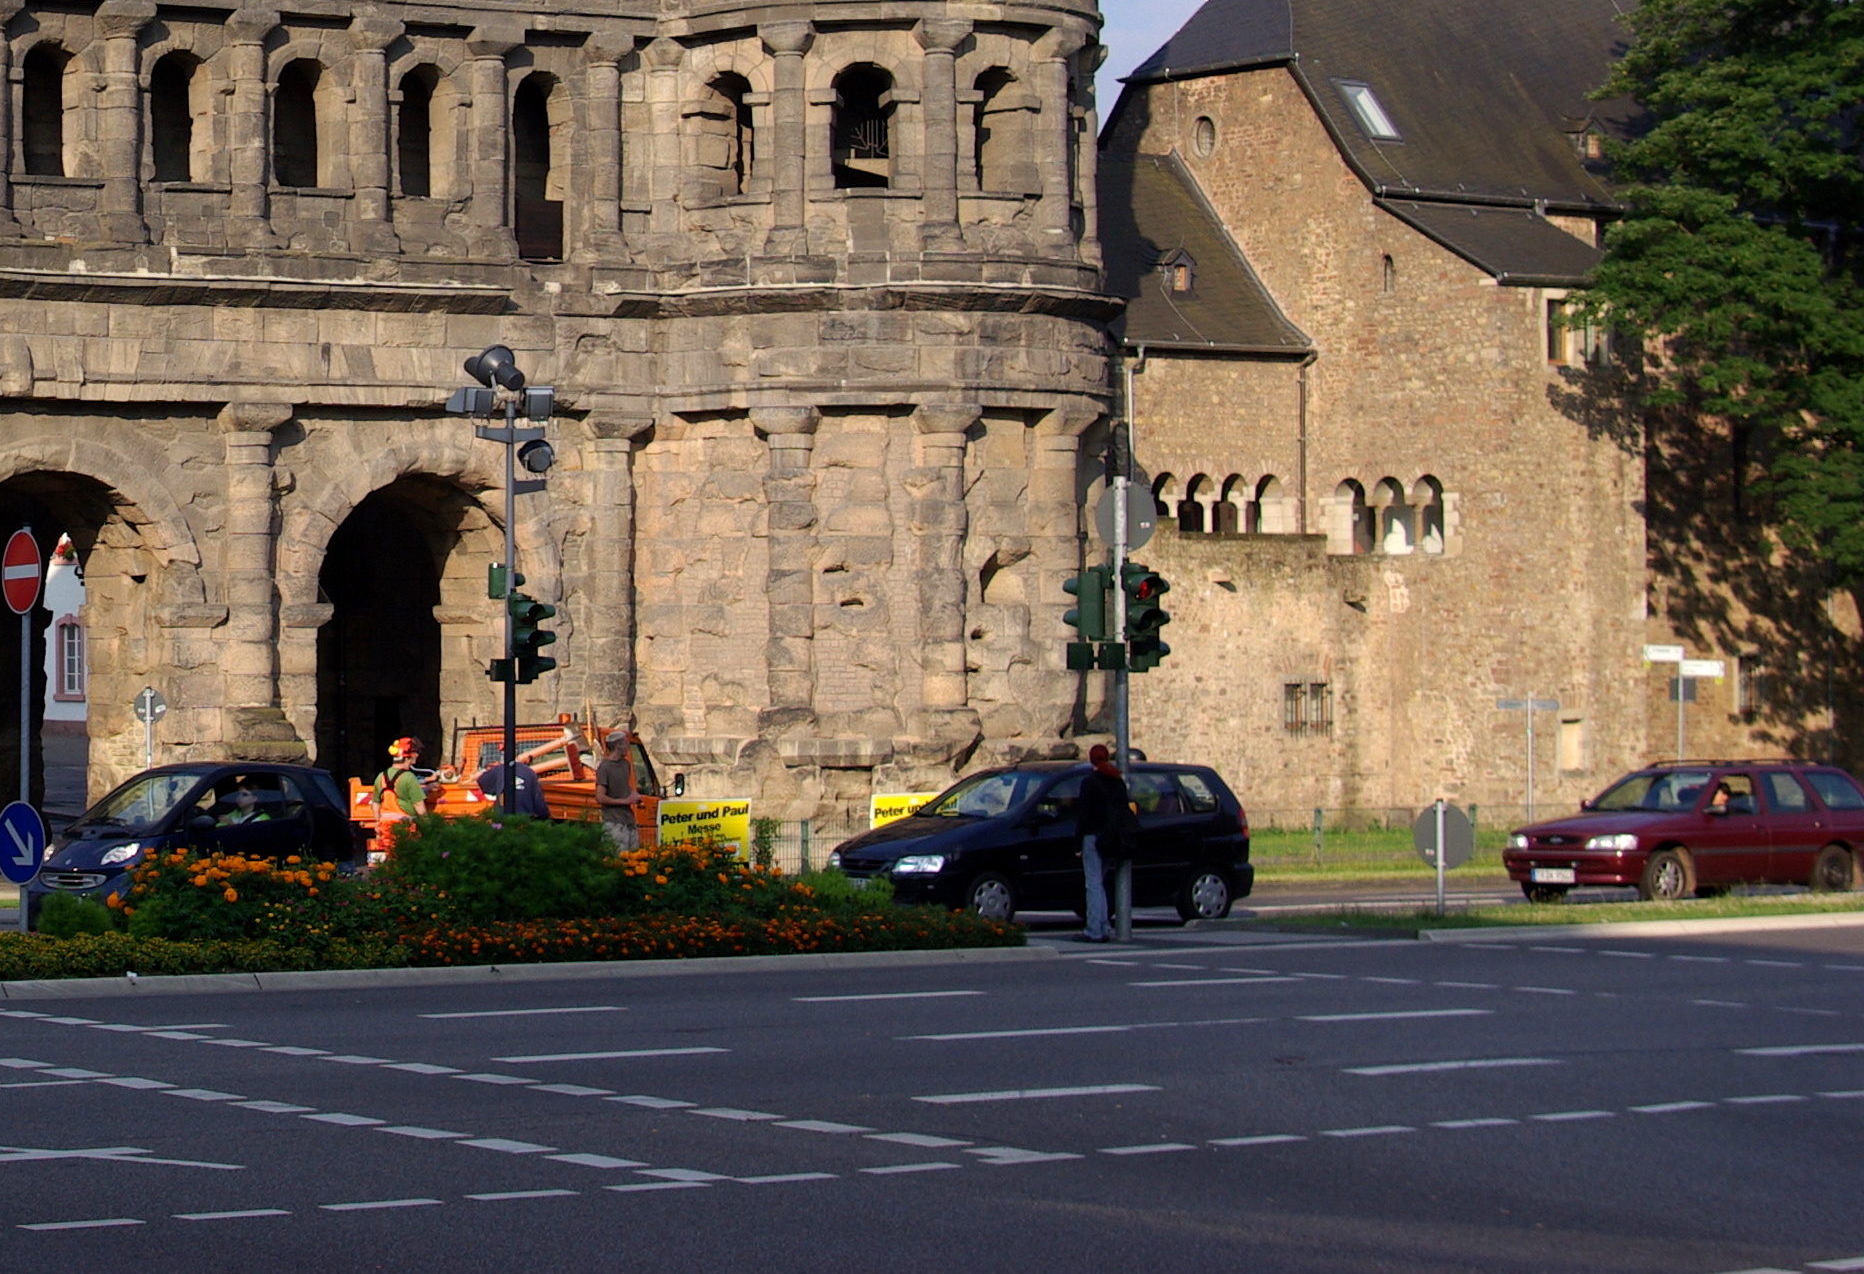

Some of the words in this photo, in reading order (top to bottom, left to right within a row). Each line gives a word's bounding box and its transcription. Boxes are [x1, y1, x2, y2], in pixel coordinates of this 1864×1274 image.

[661, 813, 693, 825] Peter
[696, 807, 719, 820] und
[722, 803, 749, 817] Paul
[874, 805, 904, 818] Peter
[687, 823, 722, 834] Messe
